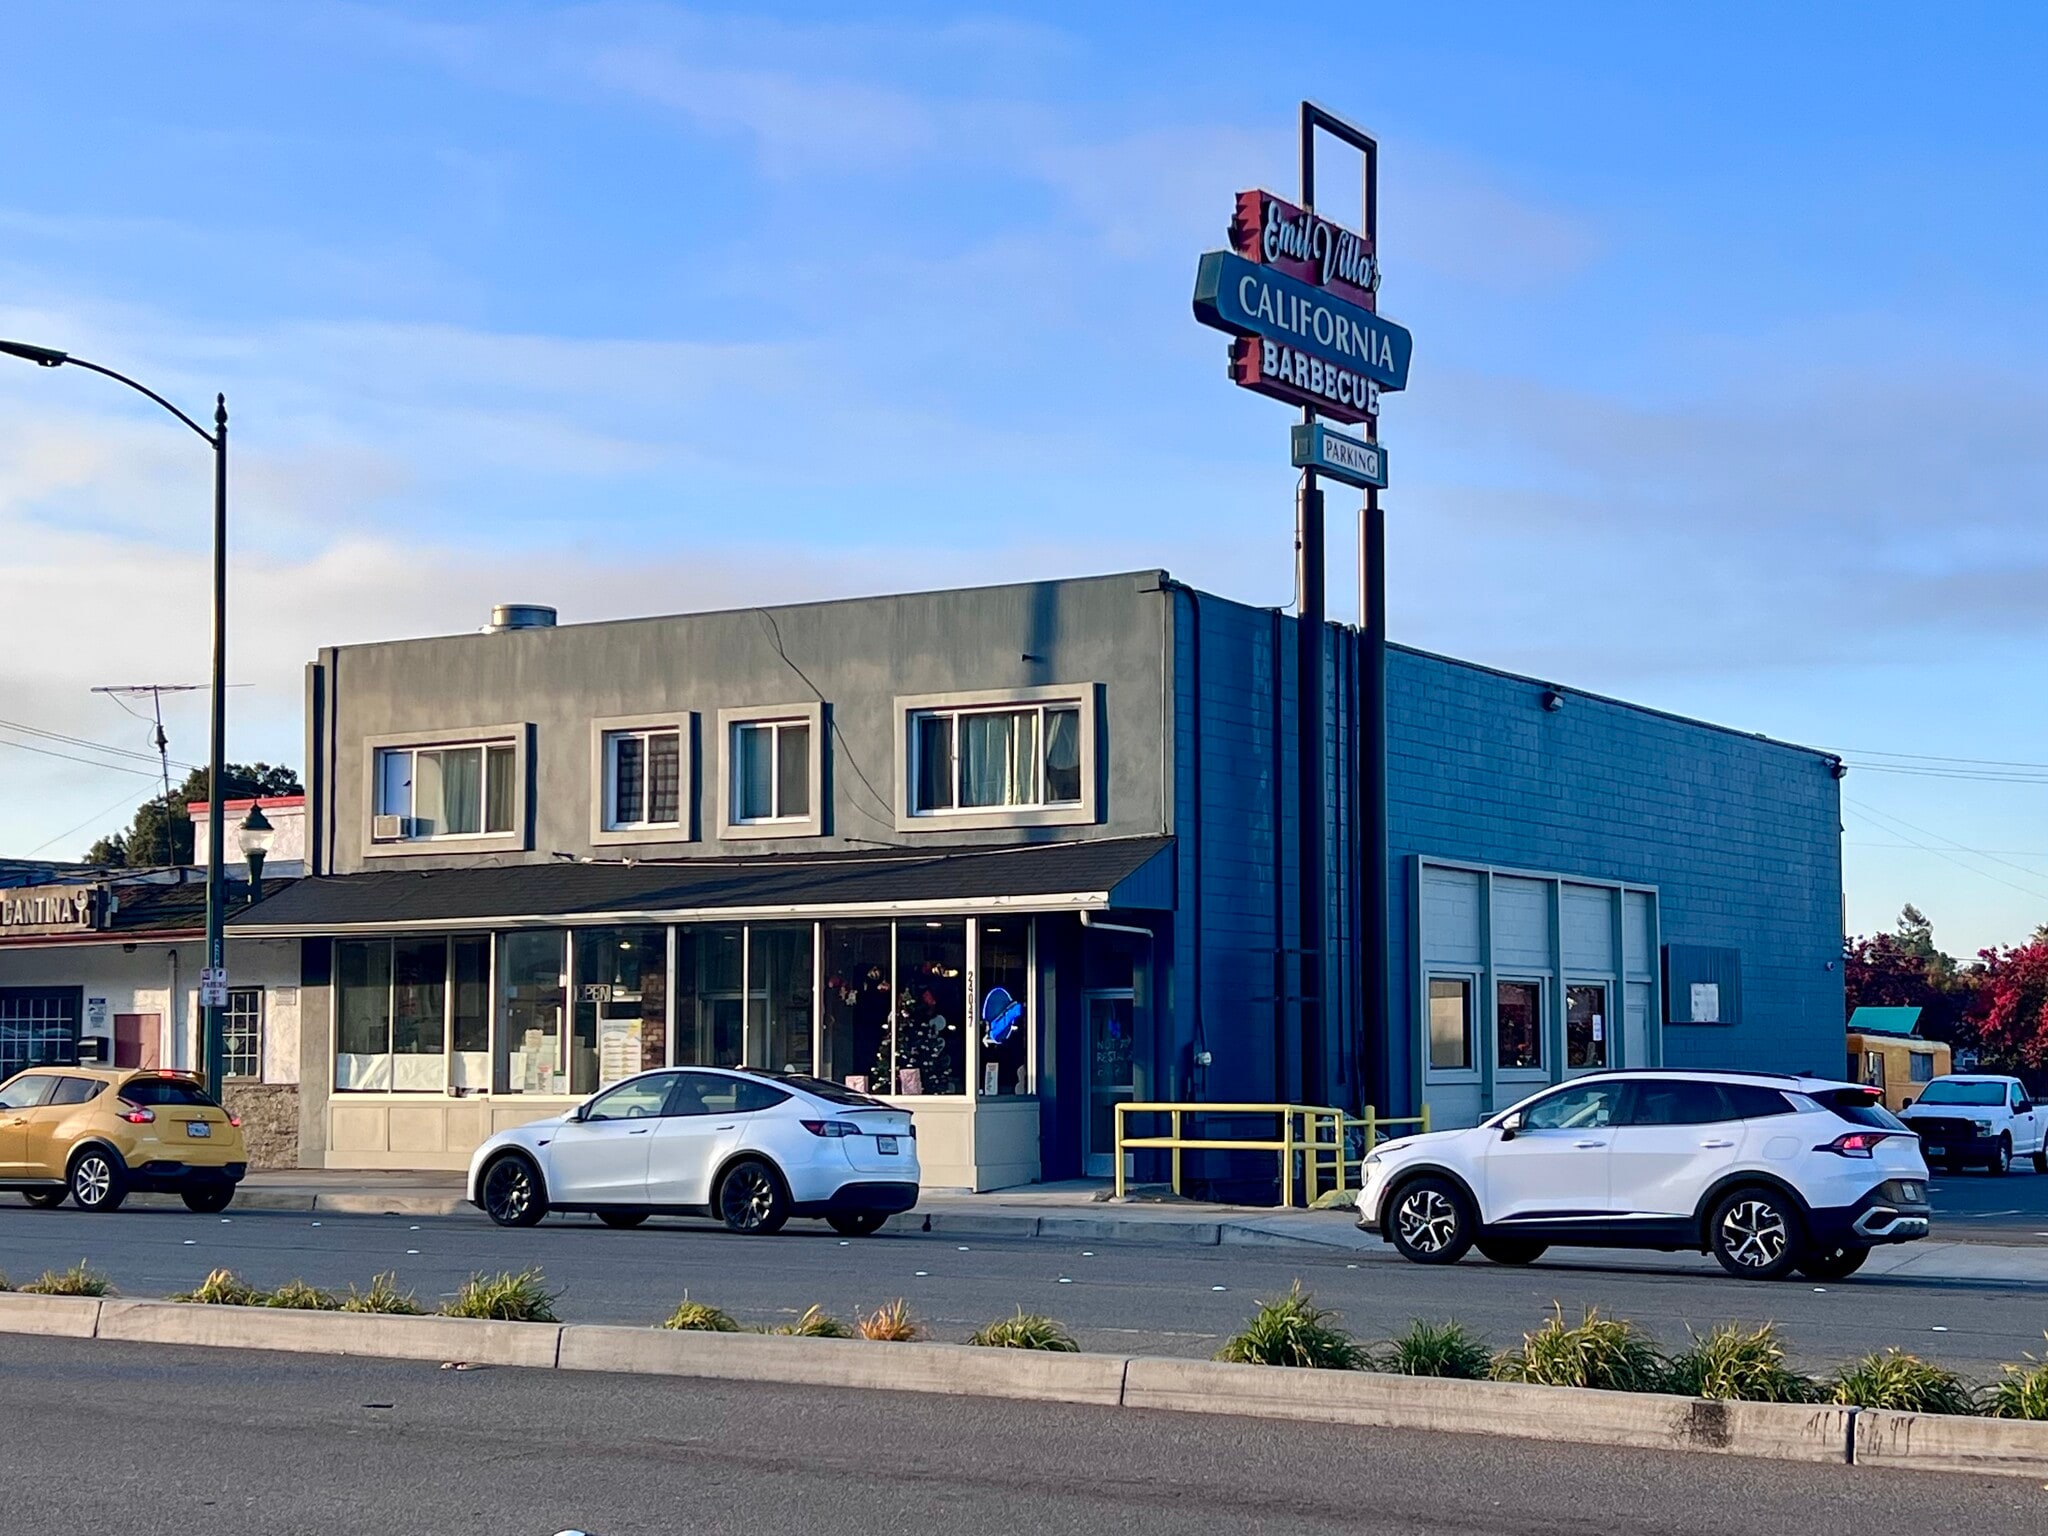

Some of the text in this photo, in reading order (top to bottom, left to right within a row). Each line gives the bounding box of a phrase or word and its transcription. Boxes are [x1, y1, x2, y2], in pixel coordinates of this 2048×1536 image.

[1264, 200, 1381, 292] Emil Villa's
[1238, 275, 1395, 373] CALIFORNIA
[1262, 338, 1380, 416] BARBECUE
[1325, 439, 1376, 475] PARKING
[2, 896, 75, 925] CANTINA
[578, 985, 609, 1001] OPEN
